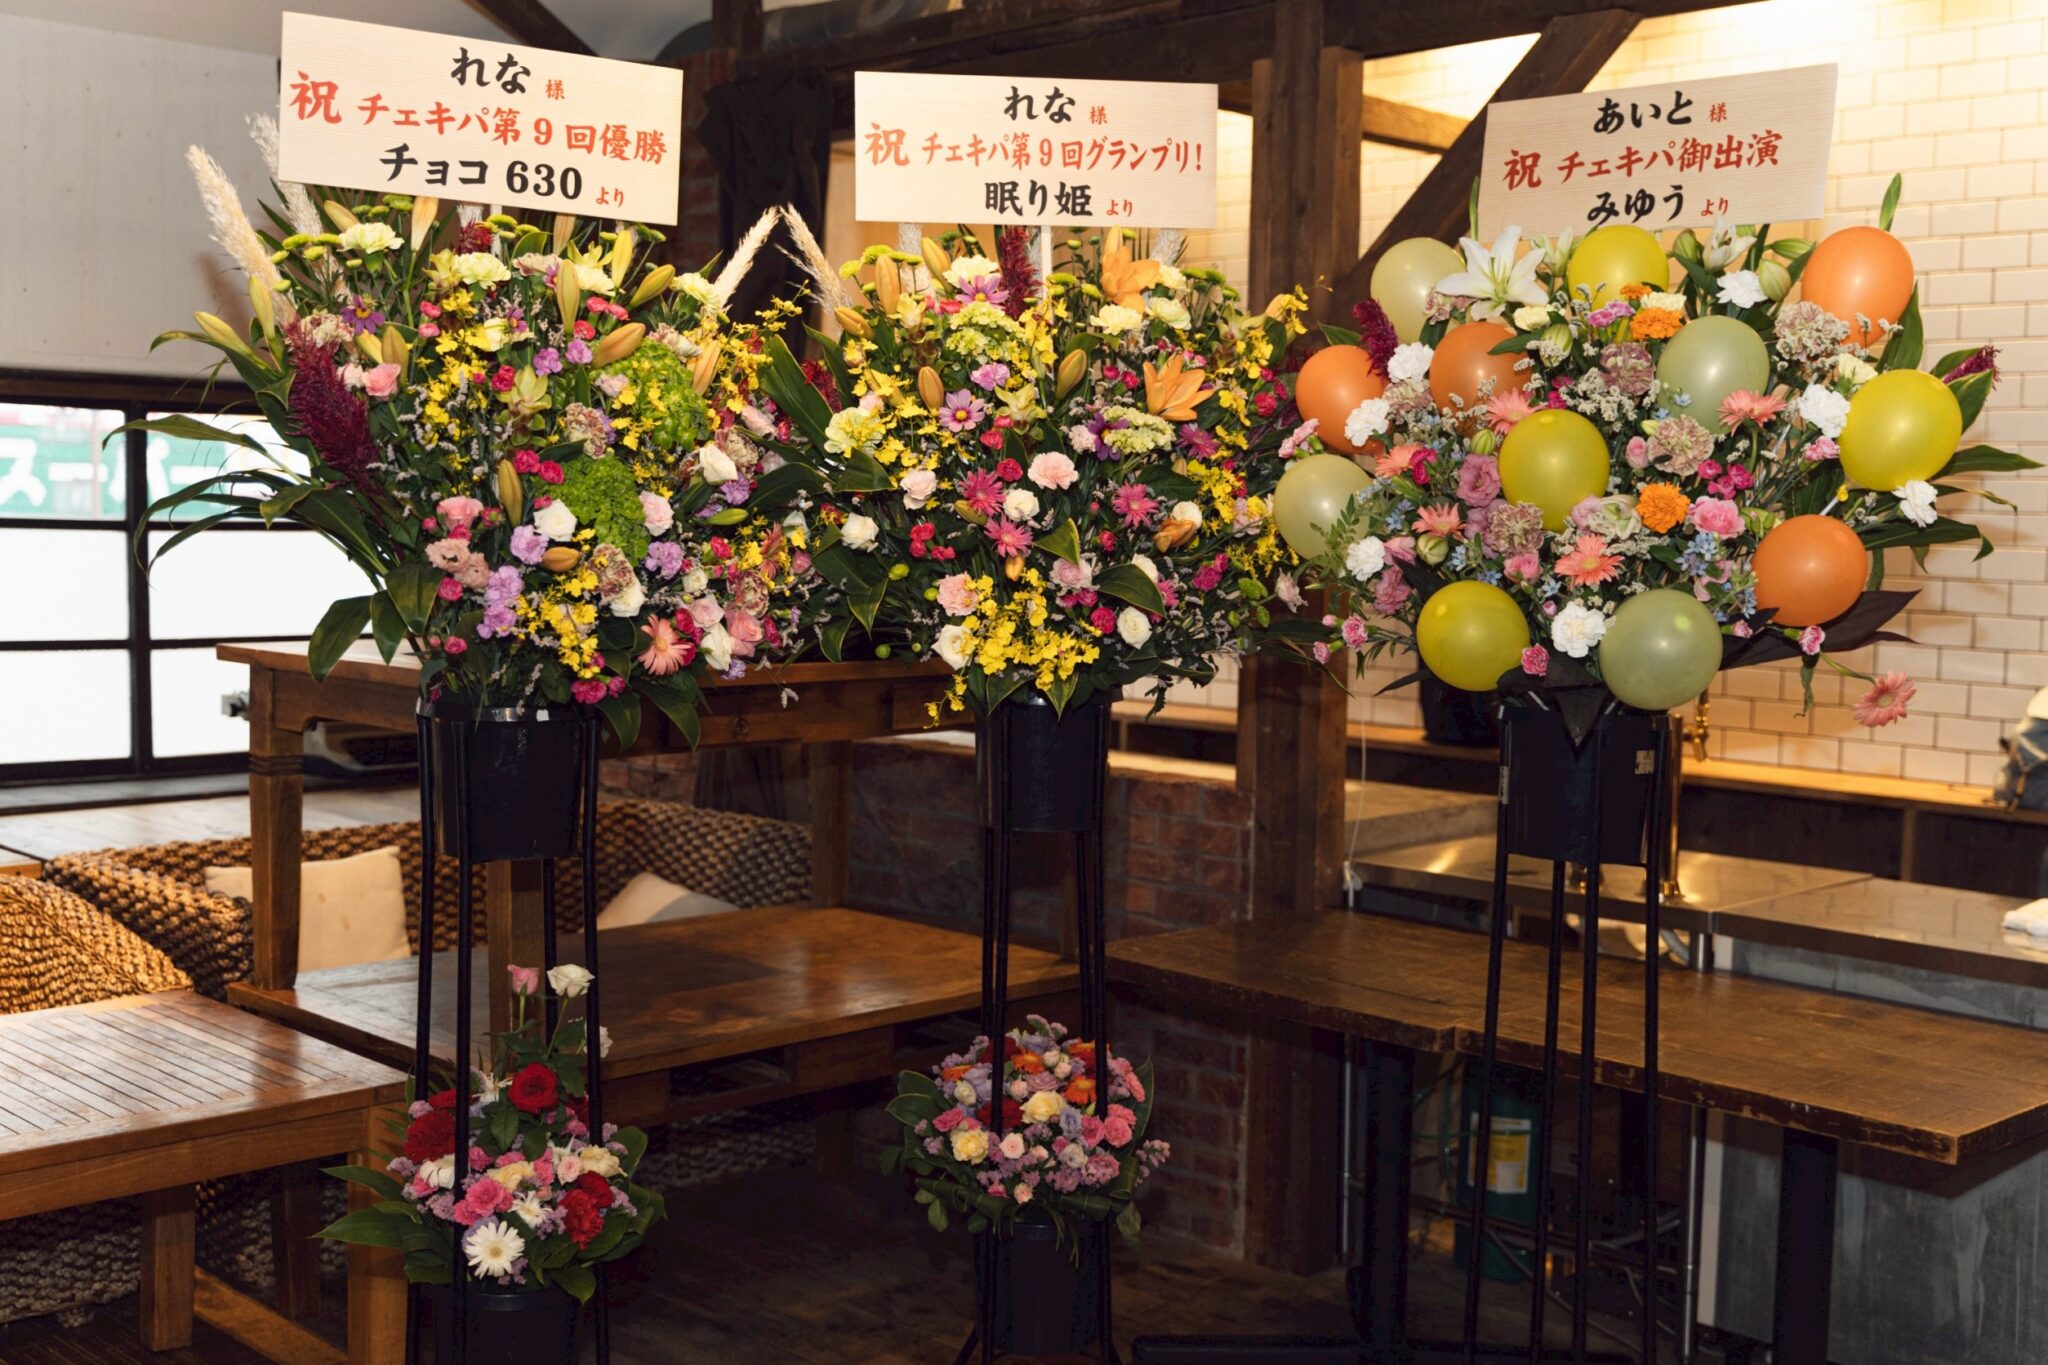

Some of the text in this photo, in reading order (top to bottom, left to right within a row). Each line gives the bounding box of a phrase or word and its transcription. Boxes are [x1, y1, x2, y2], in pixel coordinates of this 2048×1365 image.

[451, 46, 566, 100] れな 様
[289, 71, 342, 124] 祝
[1004, 86, 1108, 125] れな 様
[1593, 90, 1727, 135] あいと 様
[865, 122, 910, 166] 祝
[1502, 129, 1783, 191] 祝 チェキパ御出演
[596, 188, 625, 207] より
[984, 180, 1133, 217] 眠り姫 より
[1587, 184, 1729, 225] みゆう より
